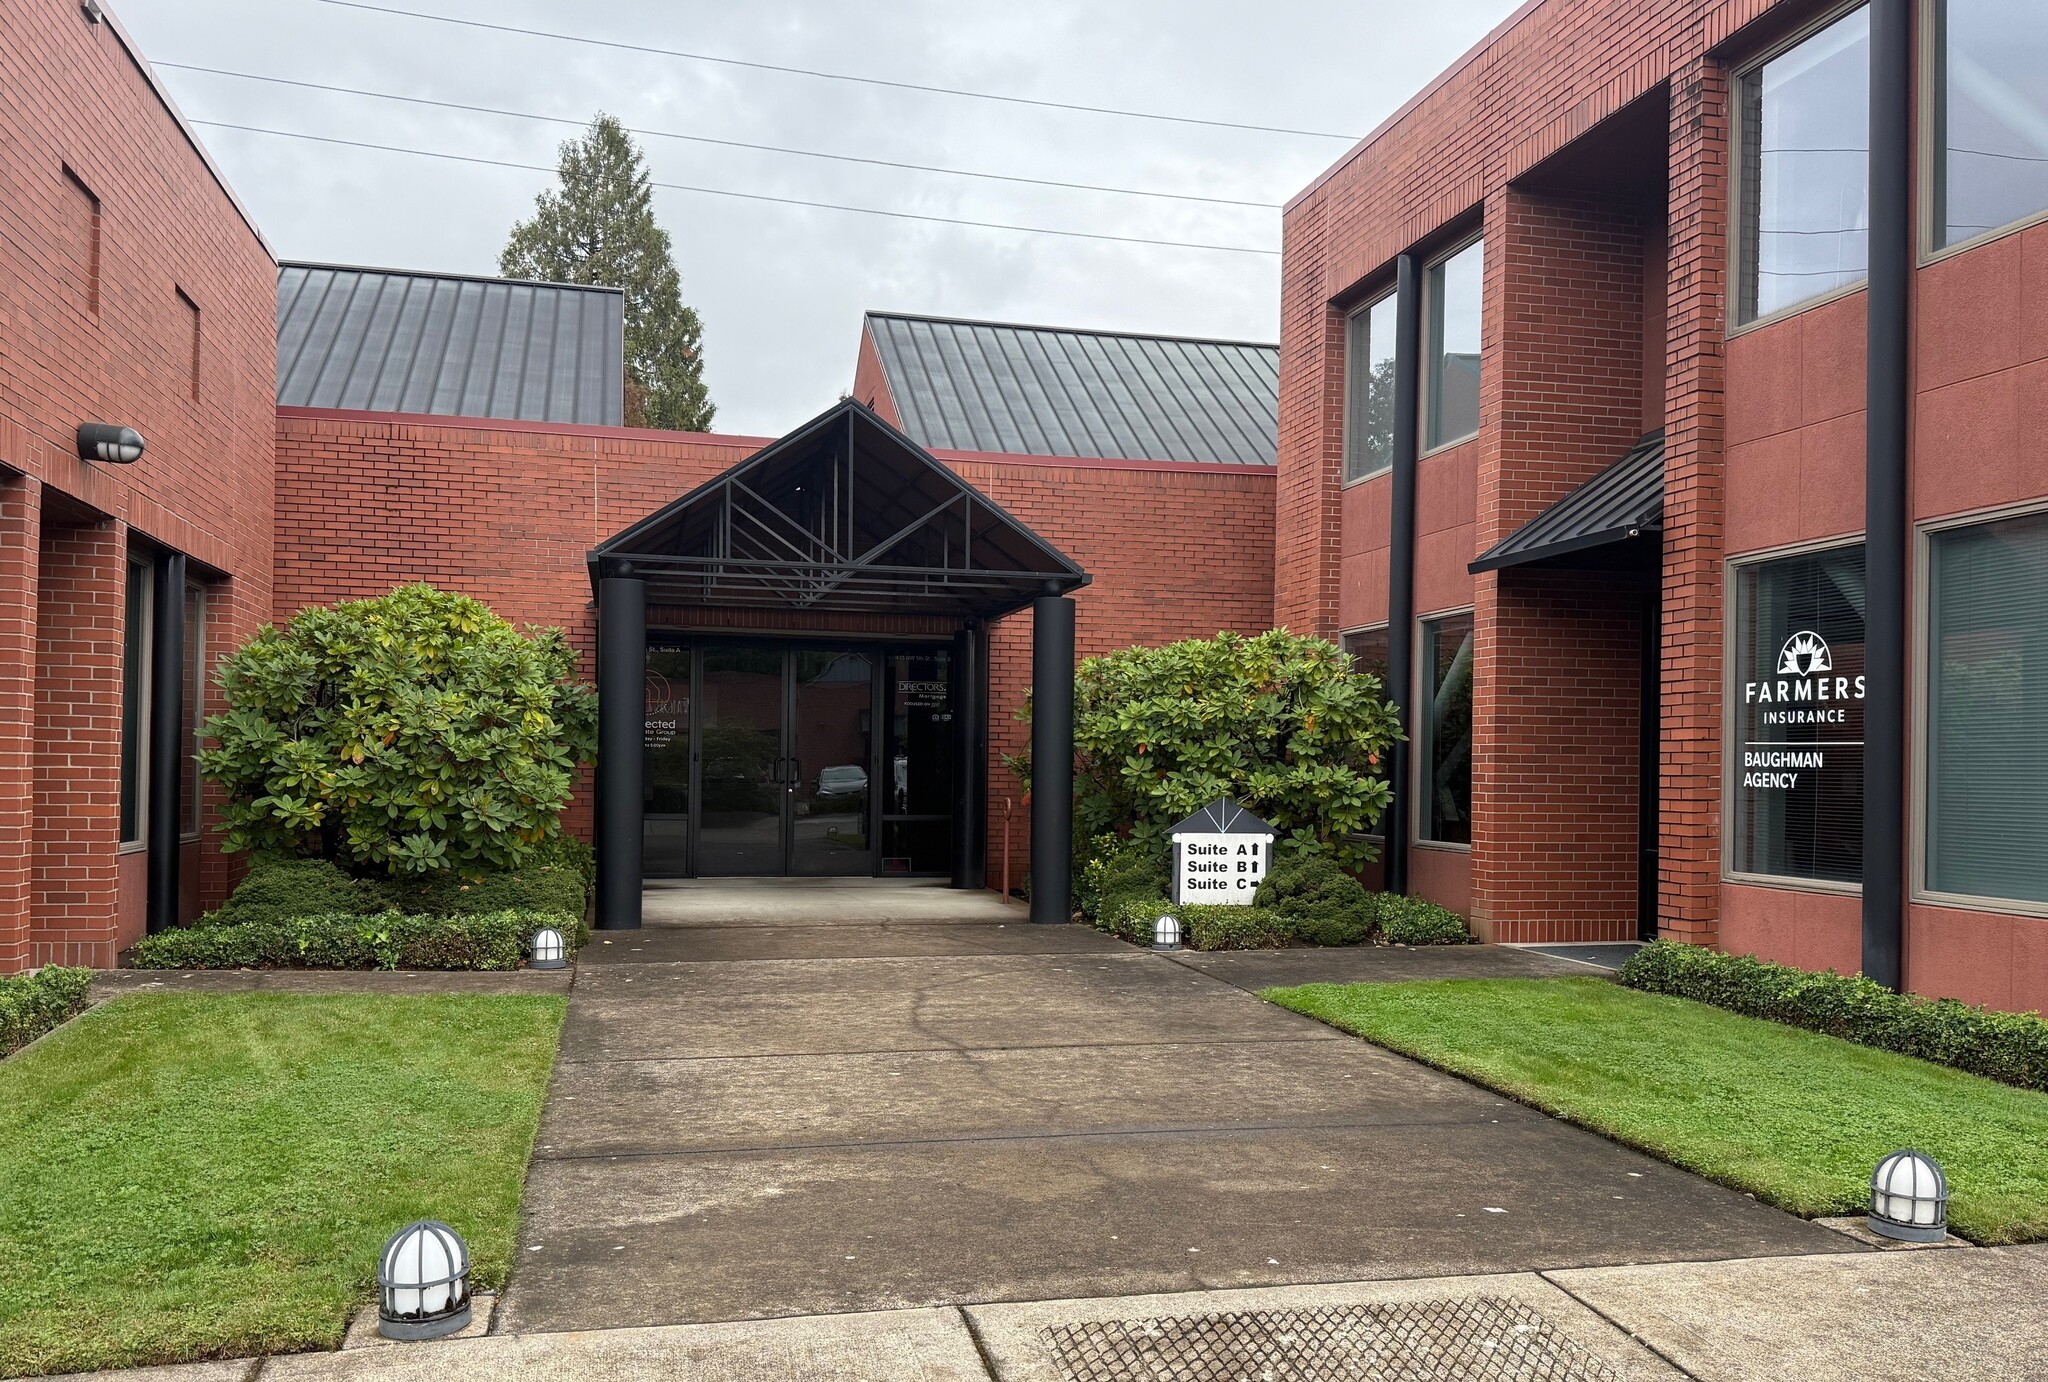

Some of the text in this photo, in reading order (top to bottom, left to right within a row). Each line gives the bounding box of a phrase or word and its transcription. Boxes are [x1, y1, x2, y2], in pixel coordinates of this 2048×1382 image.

[1745, 676, 1866, 704] FARMERS
[1763, 709, 1845, 724] INSURANCE
[644, 719, 676, 729] ected
[1744, 751, 1823, 768] BAUGHMAN
[1743, 771, 1798, 789] AGENCY
[1187, 843, 1248, 855] Suite A
[1187, 860, 1247, 873] Suite B
[1187, 878, 1247, 890] Suite C
